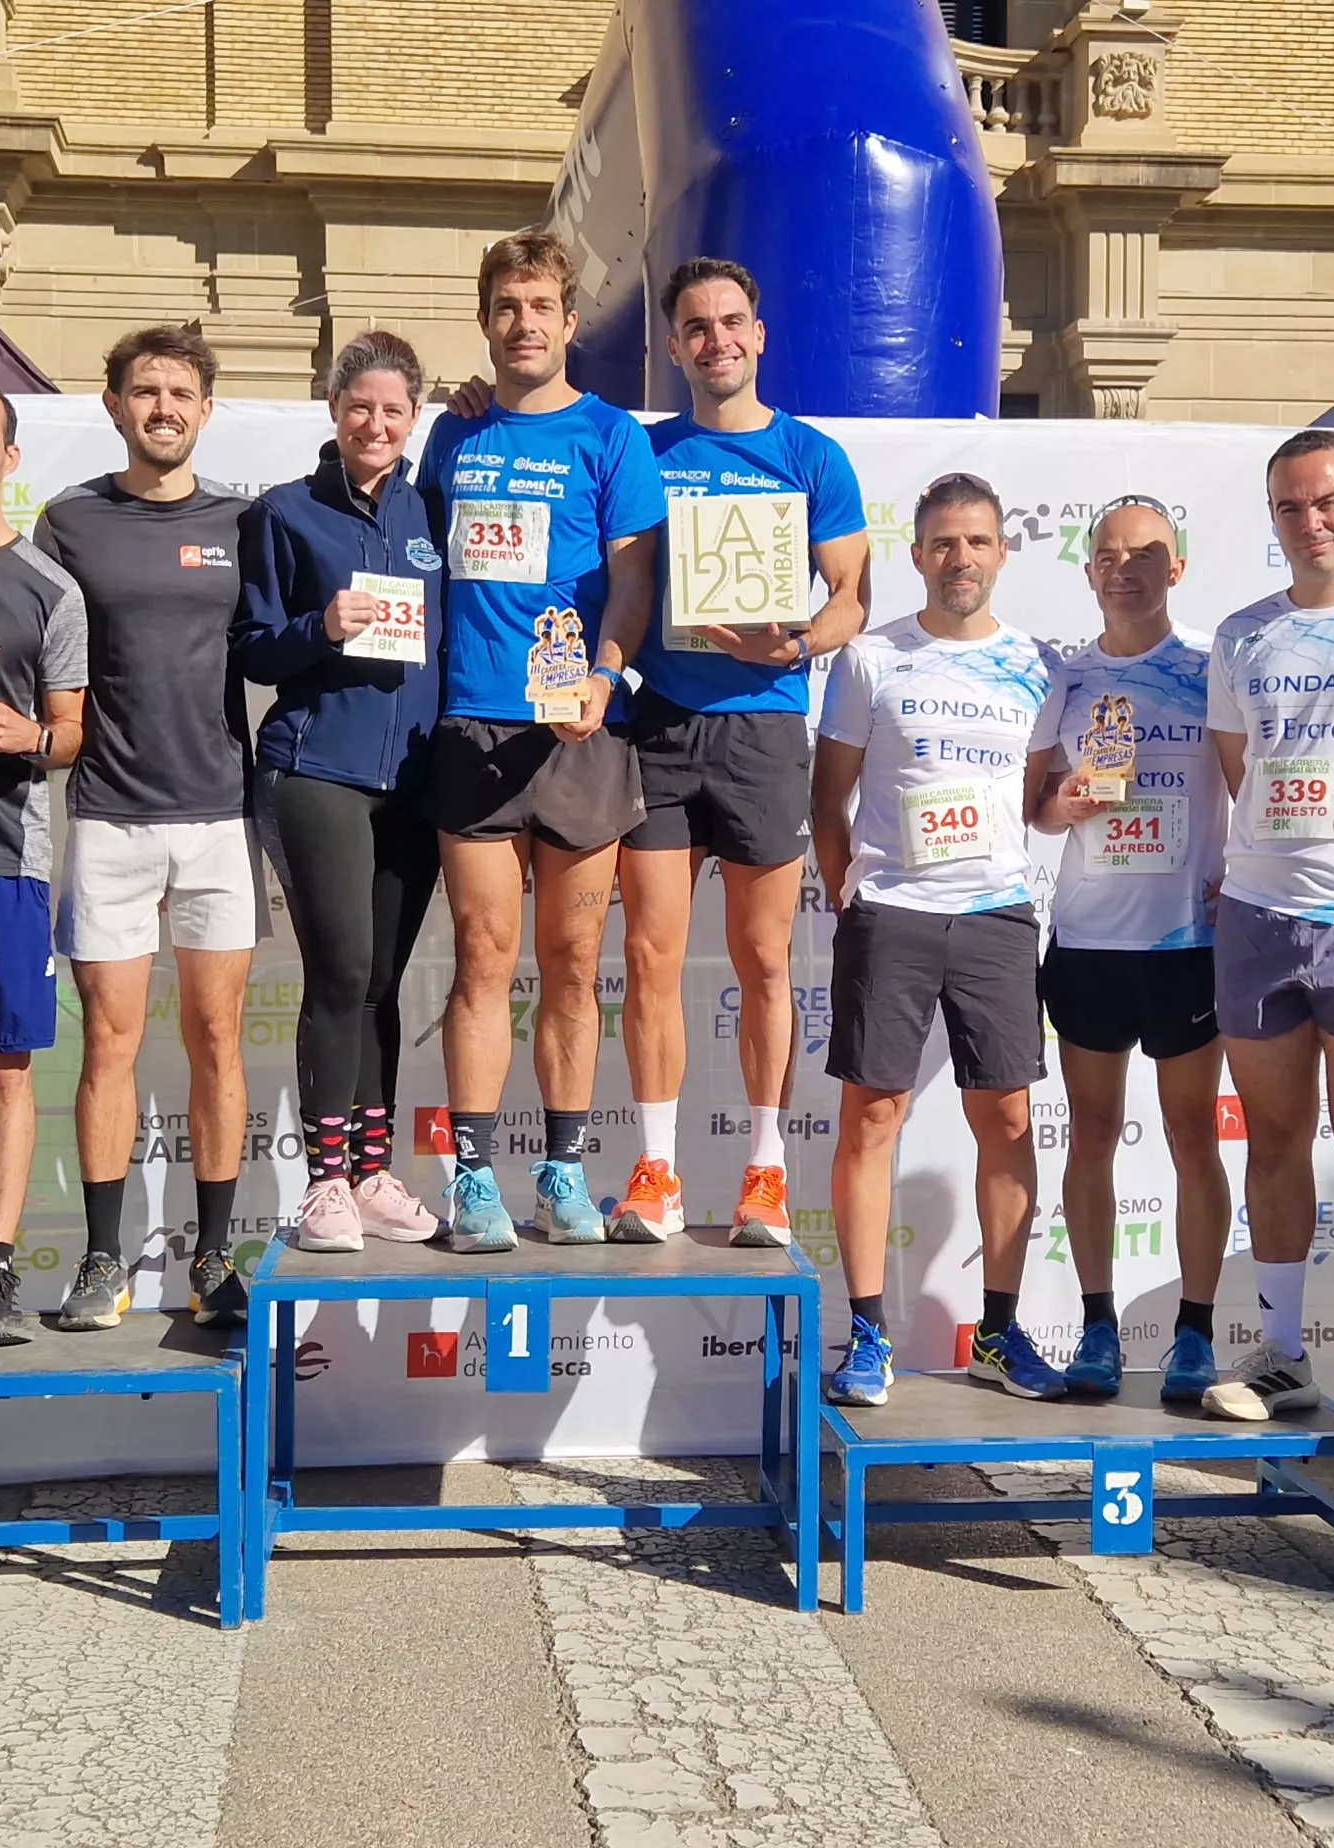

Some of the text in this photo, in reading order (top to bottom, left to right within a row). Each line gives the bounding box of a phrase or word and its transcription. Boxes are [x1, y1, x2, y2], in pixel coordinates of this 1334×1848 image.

[525, 457, 571, 475] kablex
[453, 470, 501, 485] NEXT
[733, 473, 781, 490] kablex
[468, 522, 523, 547] 333
[692, 504, 764, 574] LA
[464, 548, 525, 561] ROBERTO
[472, 560, 489, 571] 8K
[772, 522, 793, 610] AMBAR
[389, 582, 422, 590] CARRE
[678, 551, 770, 614] 125
[378, 639, 397, 651] 8K
[690, 638, 708, 649] 8K
[540, 665, 586, 685] EMPRESAS
[539, 703, 546, 719] 1
[901, 699, 1028, 726] BONDALTI
[938, 738, 1013, 767] Ercros
[1092, 749, 1134, 766] EMPRESAS
[1284, 759, 1330, 767] CARRERA
[1137, 771, 1184, 788] cros
[1082, 783, 1090, 797] 3
[1269, 779, 1327, 803] 339
[920, 806, 979, 833] 340
[1265, 806, 1327, 817] ERNESTO
[1106, 817, 1160, 841] 341
[1272, 819, 1291, 830] 8K
[925, 832, 978, 846] CARLOS
[932, 847, 950, 858] 8K
[1103, 844, 1165, 853] ALFREDO
[1111, 855, 1130, 866] 8K
[711, 1113, 830, 1140] ibeaja
[502, 1304, 530, 1358] 1
[1102, 1471, 1144, 1525] 3
